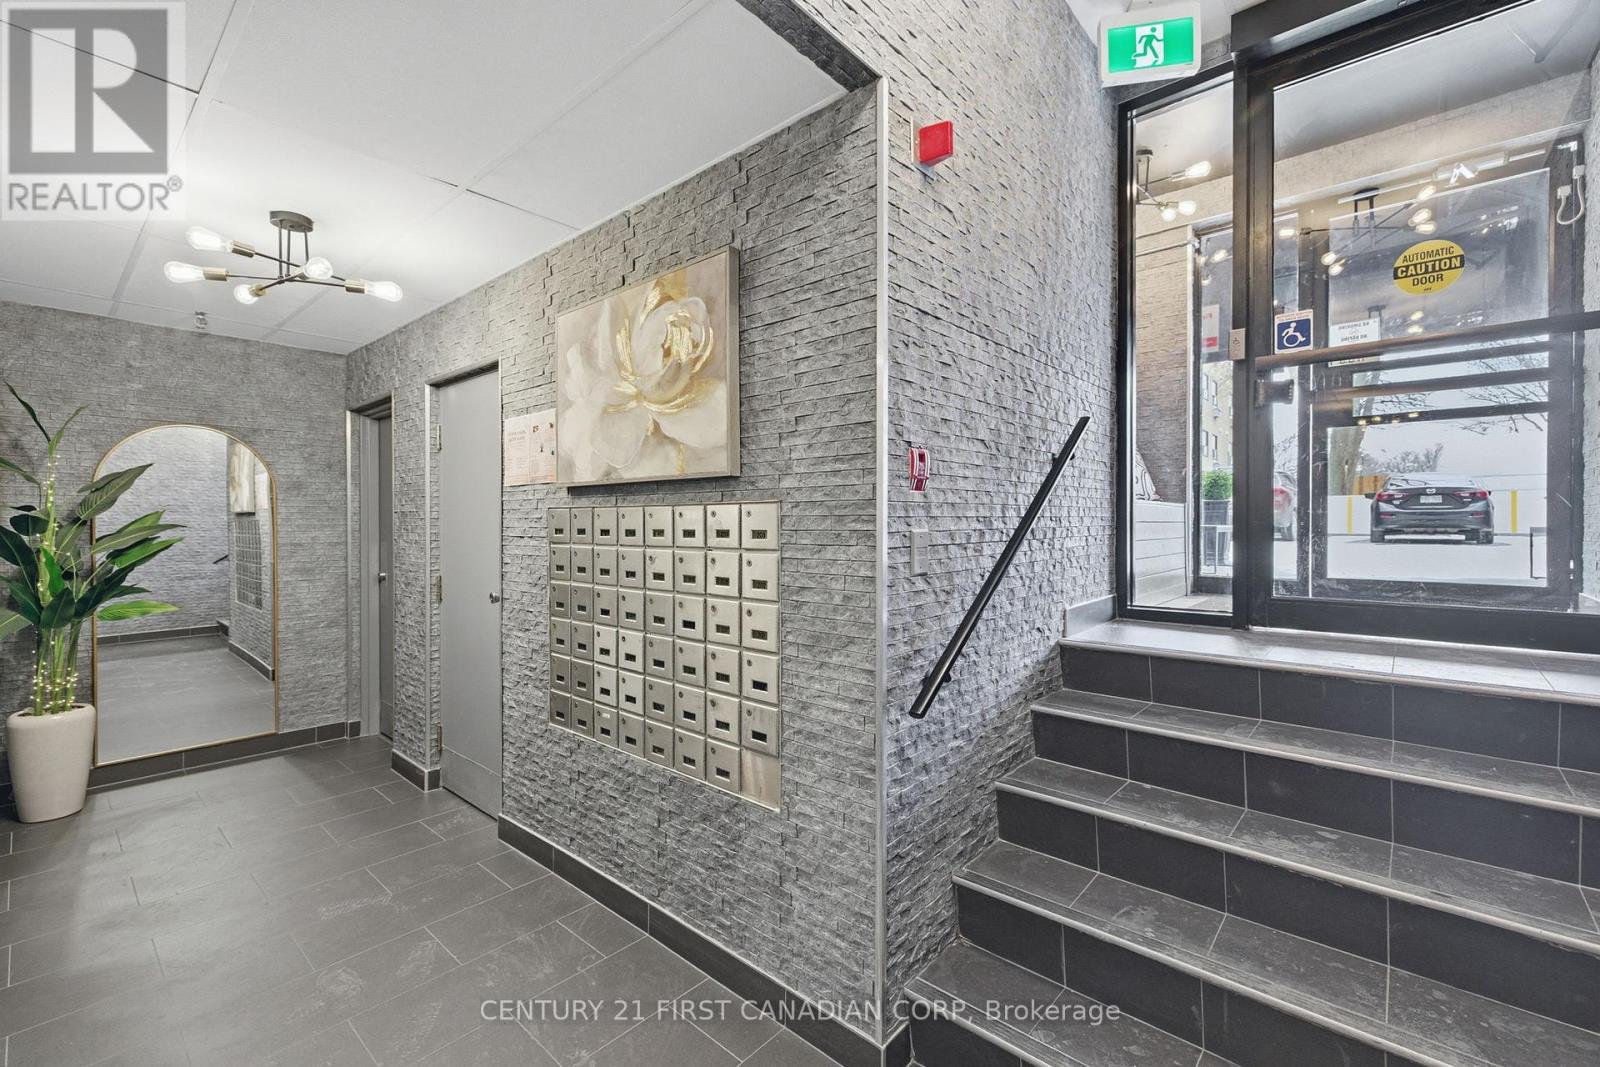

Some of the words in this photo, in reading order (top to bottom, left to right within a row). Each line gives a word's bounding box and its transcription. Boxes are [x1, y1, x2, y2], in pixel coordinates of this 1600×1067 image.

[1401, 245, 1455, 264] AUTOMATIC
[1397, 256, 1461, 278] CAUTION
[1412, 273, 1444, 287] DOOR
